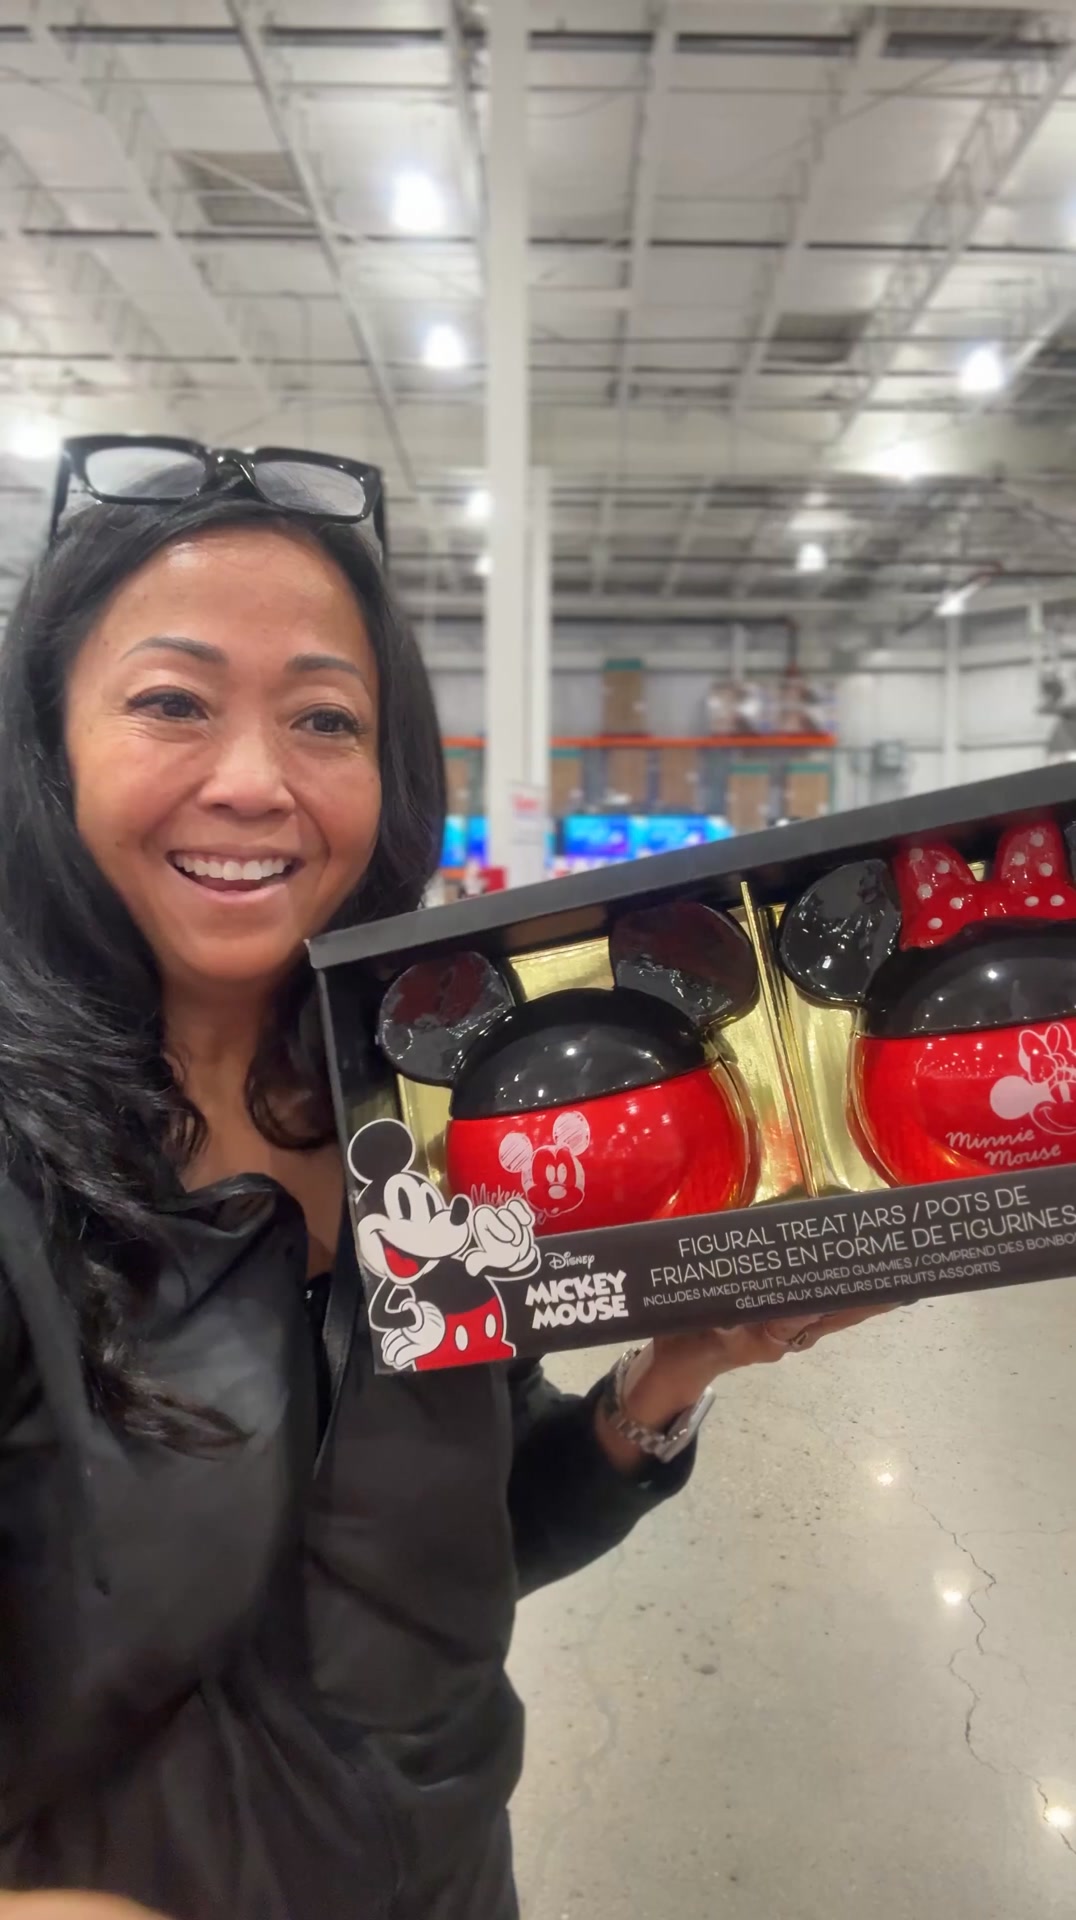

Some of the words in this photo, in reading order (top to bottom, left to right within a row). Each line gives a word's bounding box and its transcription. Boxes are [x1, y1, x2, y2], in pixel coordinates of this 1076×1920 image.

[945, 1127, 1035, 1149] Minnie
[984, 1144, 1061, 1167] Mouse
[678, 1227, 775, 1258] FIGURAL
[776, 1213, 848, 1242] TREAT
[852, 1205, 906, 1236] JARS
[912, 1202, 920, 1223] /
[925, 1192, 990, 1219] POTS
[995, 1185, 1031, 1209] DE
[650, 1250, 782, 1288] FRIANDISES
[786, 1244, 819, 1267] EN
[822, 1231, 908, 1262] FORME
[911, 1225, 946, 1248] DE
[949, 1205, 1076, 1242] FIGURINES
[525, 1269, 627, 1307] MICKEY
[643, 1288, 701, 1307] INCLUDES
[702, 1282, 741, 1298] MIXED
[741, 1277, 775, 1293] FRUIT
[775, 1266, 850, 1288] FLAVOURED
[852, 1256, 913, 1276] GUMMIES
[914, 1256, 920, 1267] /
[921, 1245, 996, 1266] COMPREND
[998, 1240, 1025, 1255] DES
[1025, 1232, 1076, 1250] BONBO
[735, 1292, 785, 1310] GÉLIFIÉS
[786, 1288, 813, 1303] AUX
[814, 1279, 873, 1299] SAVEURS
[874, 1275, 892, 1290] DE
[893, 1269, 937, 1286] FRUITS
[938, 1260, 1001, 1280] ASSORTIS
[532, 1294, 629, 1330] MOUSE
